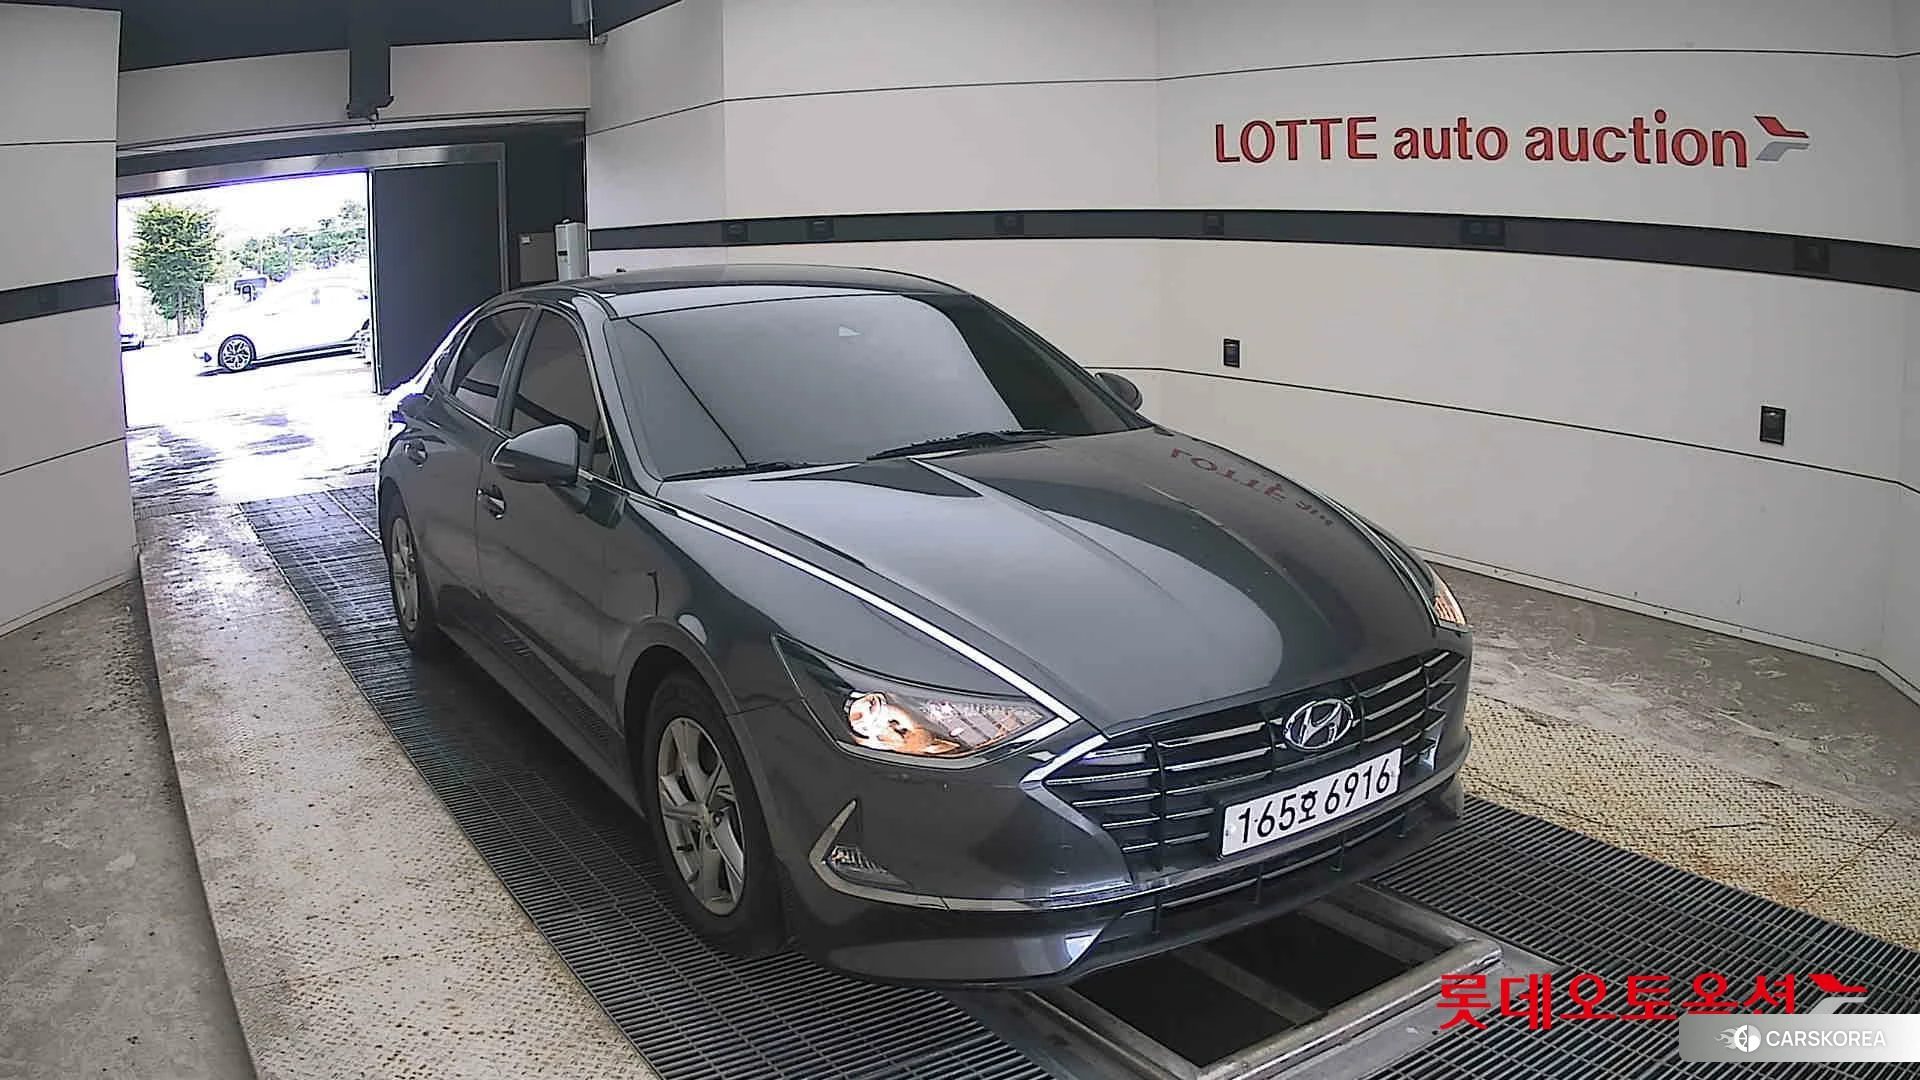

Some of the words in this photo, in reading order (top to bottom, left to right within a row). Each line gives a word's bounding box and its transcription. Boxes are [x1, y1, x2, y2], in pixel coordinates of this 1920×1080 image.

[1214, 116, 1377, 163] LOTTE
[1392, 117, 1509, 162] auto
[1525, 108, 1748, 169] auction
